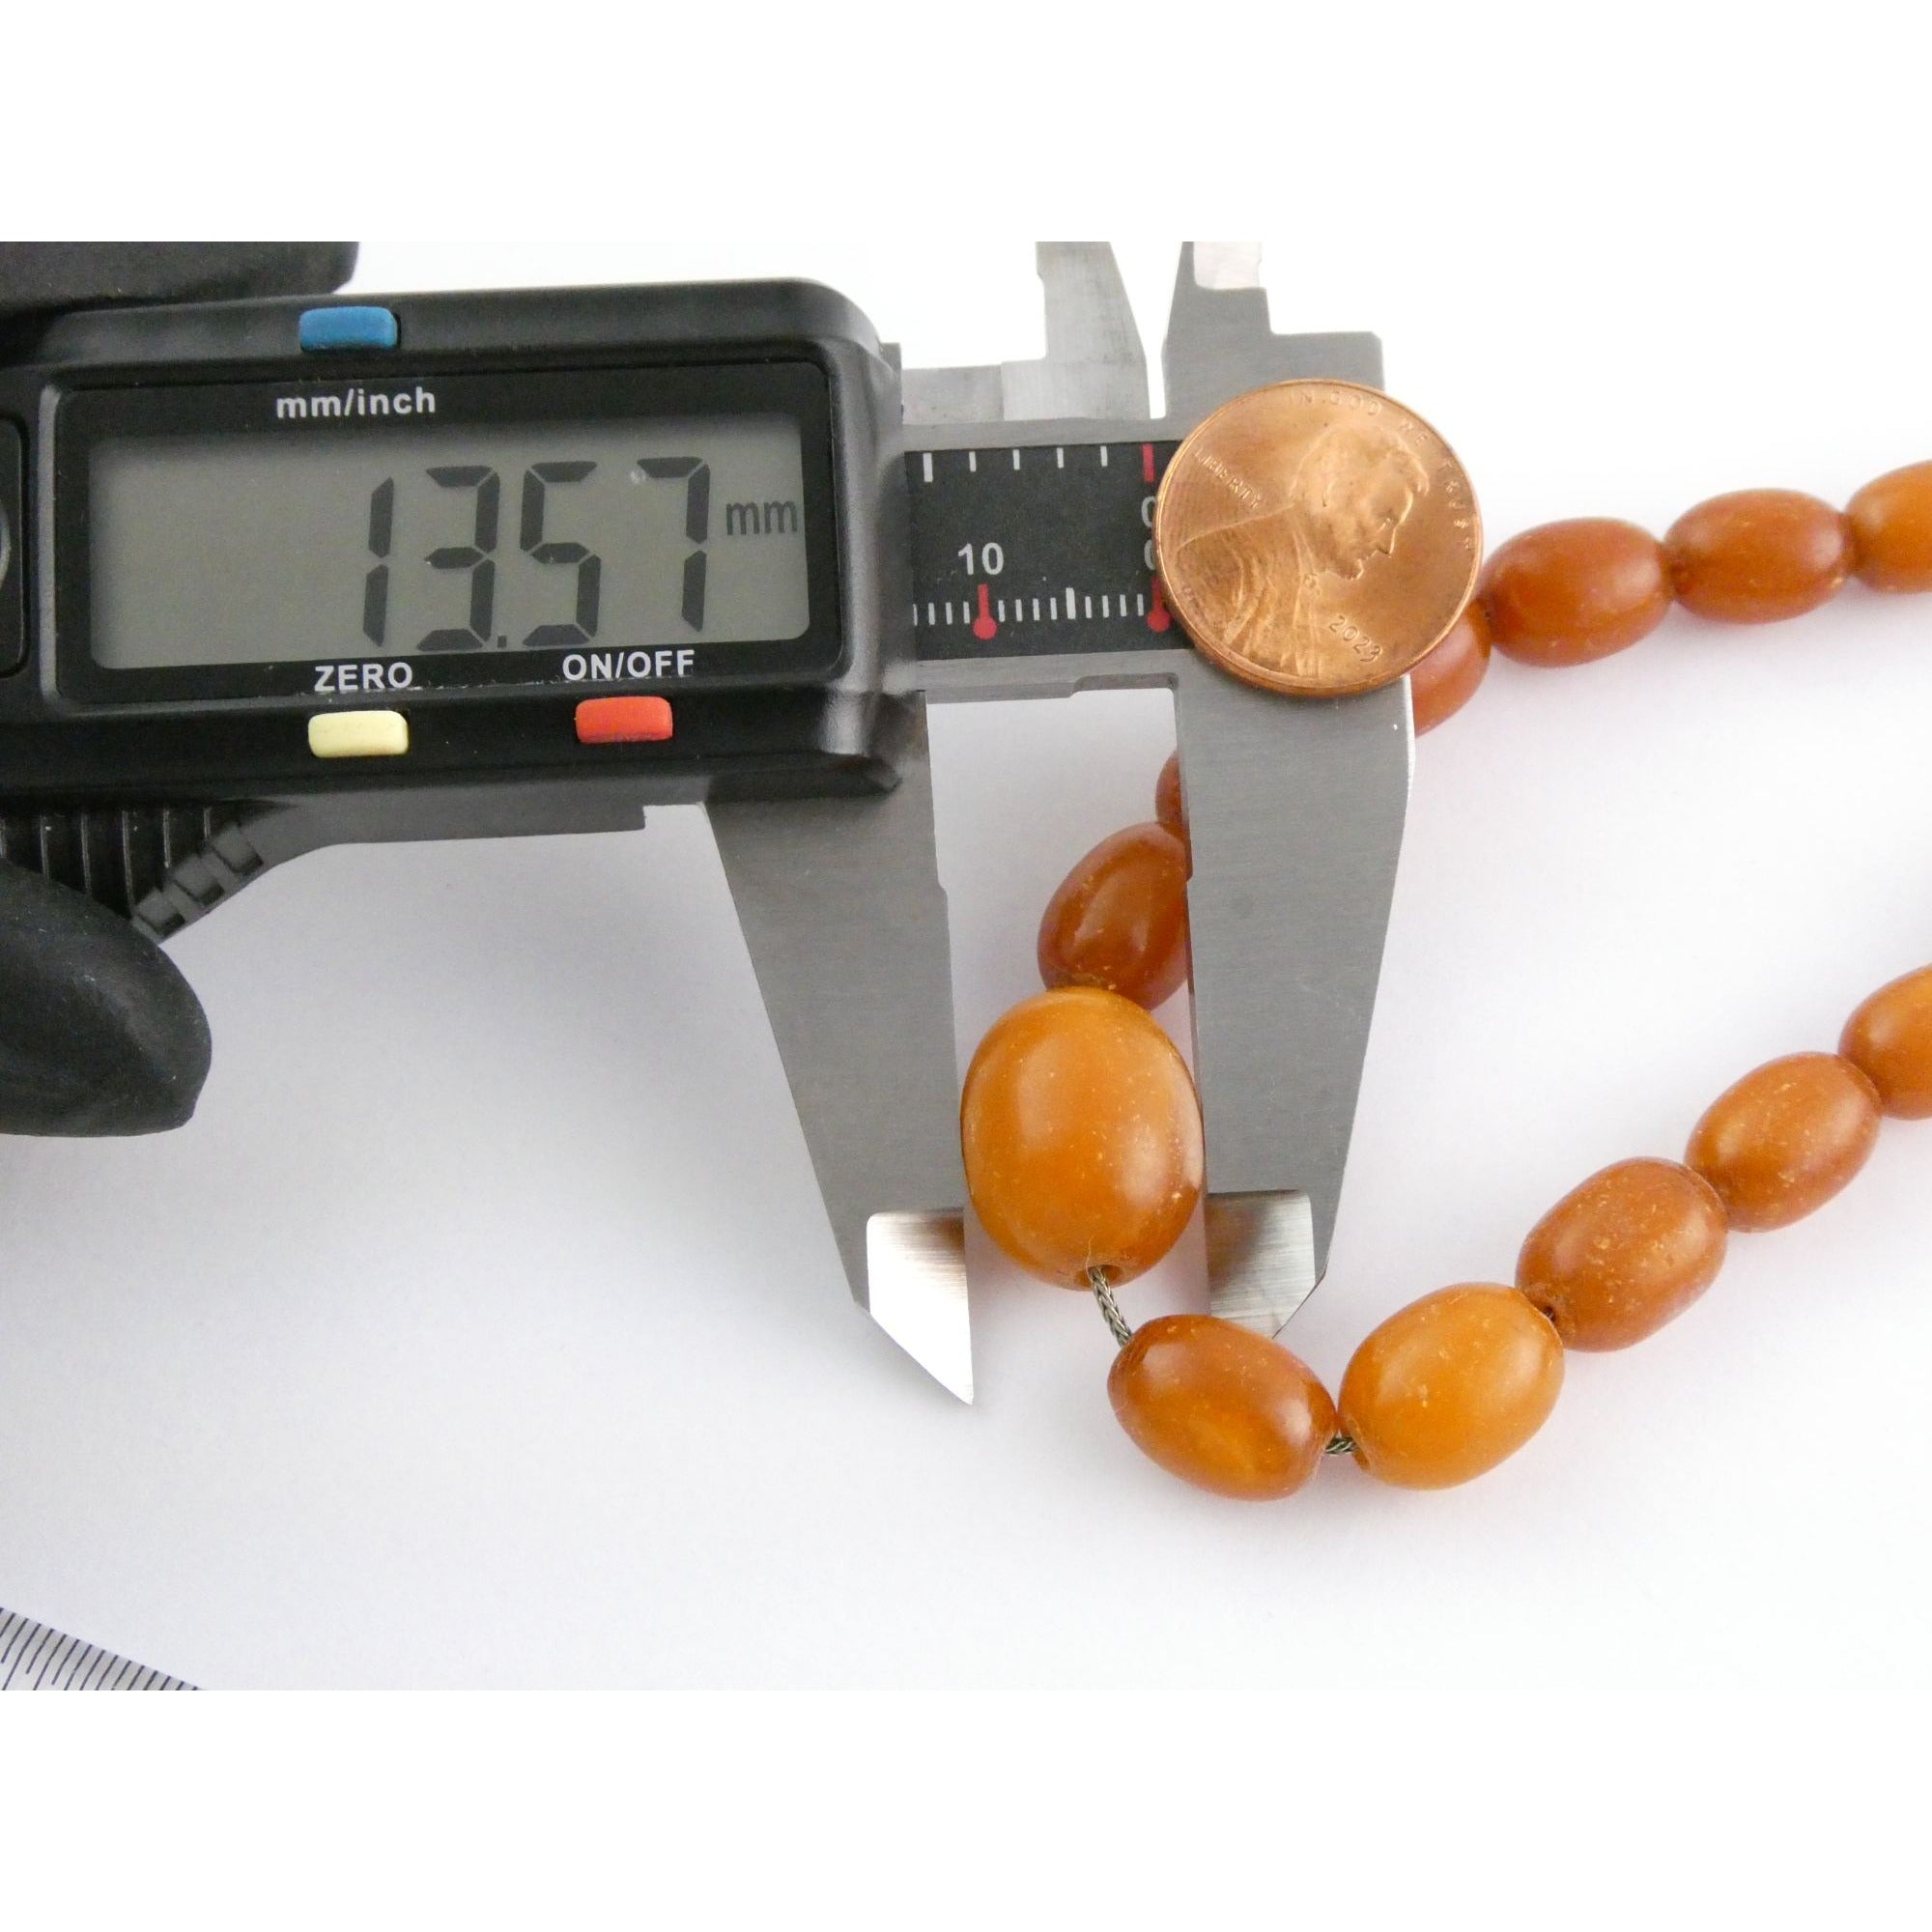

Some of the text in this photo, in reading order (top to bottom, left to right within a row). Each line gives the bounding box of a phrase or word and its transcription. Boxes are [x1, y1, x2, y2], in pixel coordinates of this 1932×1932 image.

[276, 386, 437, 419] mm/inch
[1329, 391, 1383, 415] GOD
[1193, 448, 1263, 510] LIBERTY
[362, 456, 799, 651] 13.57 mm
[957, 542, 1005, 576] 10
[1326, 613, 1384, 665] 2023
[314, 661, 413, 693] ZERO
[562, 649, 696, 682] ON/OFF
